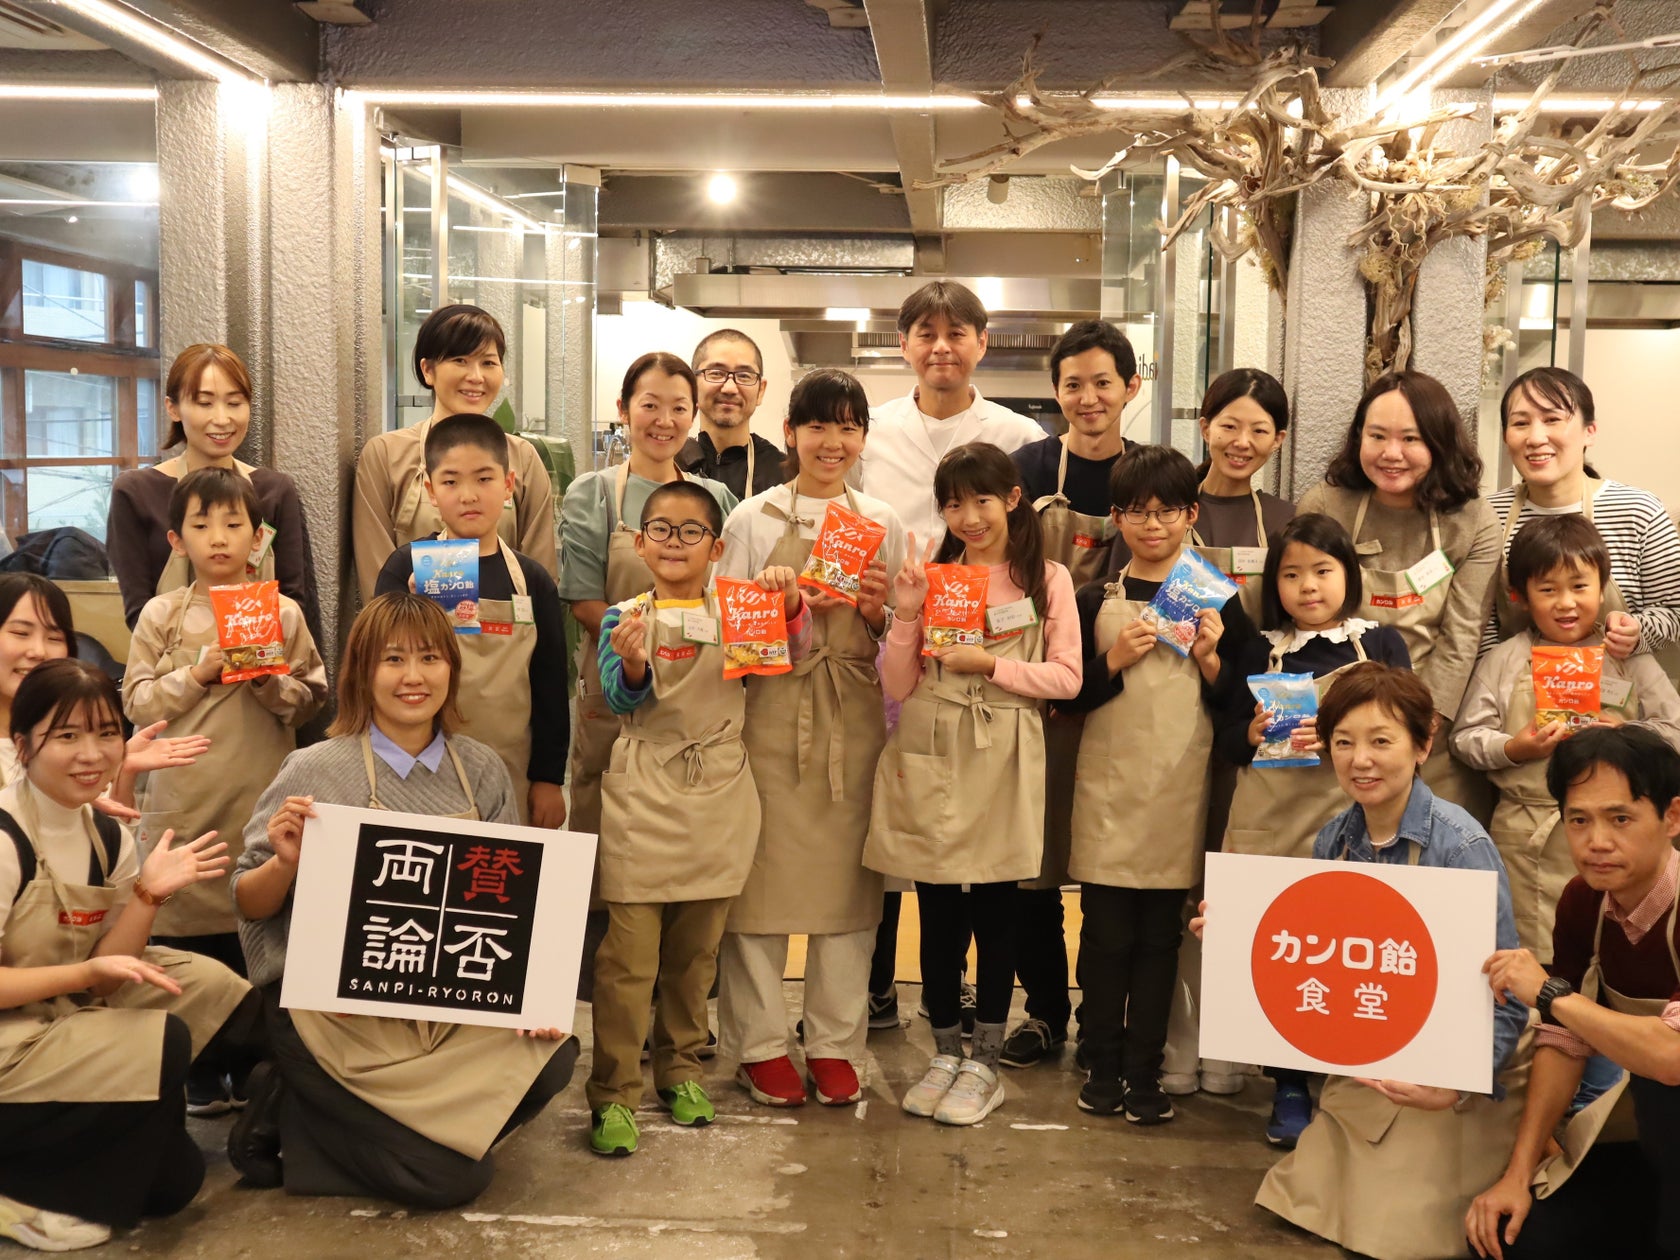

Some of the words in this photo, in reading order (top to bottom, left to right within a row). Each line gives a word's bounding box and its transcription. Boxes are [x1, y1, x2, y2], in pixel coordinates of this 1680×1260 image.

[423, 579, 475, 595] 塩カンロ飴
[933, 592, 980, 608] Kanro
[730, 606, 779, 621] Kanro
[1542, 675, 1595, 691] Kanro
[1270, 929, 1418, 976] カンロ飴
[349, 978, 513, 1005] SANPI-RYORON
